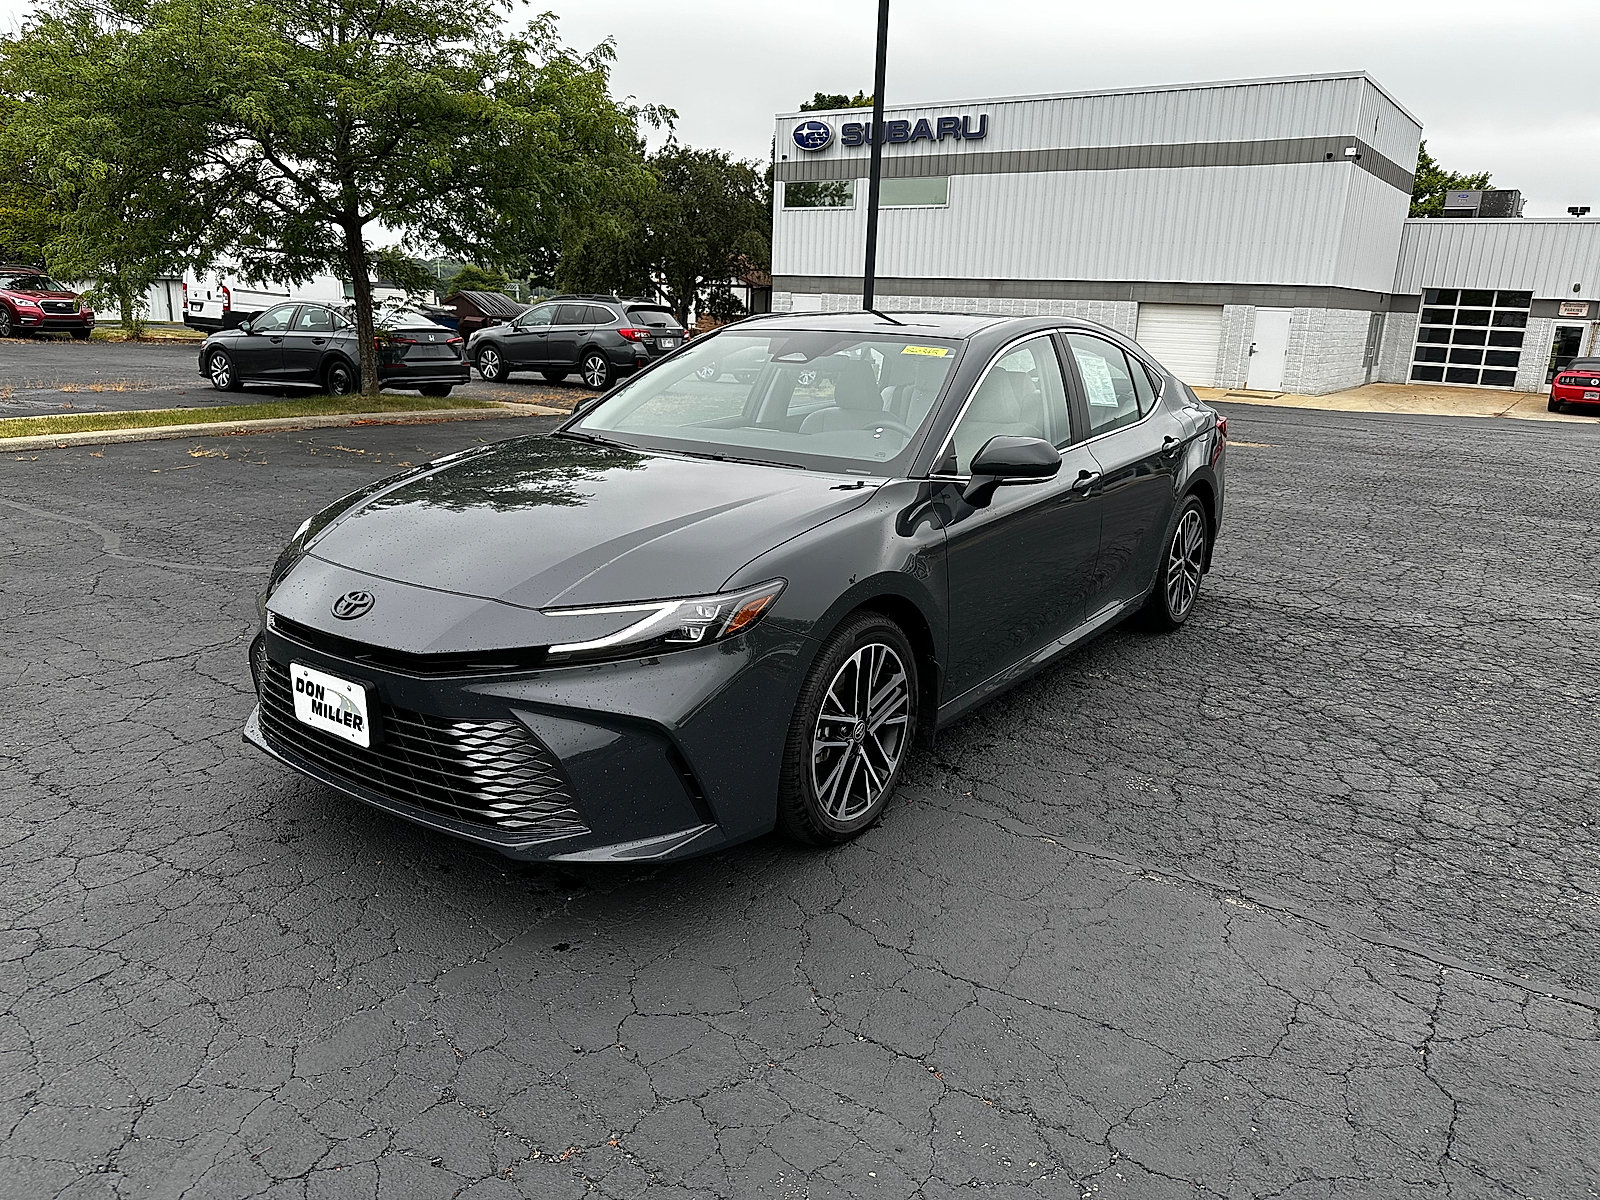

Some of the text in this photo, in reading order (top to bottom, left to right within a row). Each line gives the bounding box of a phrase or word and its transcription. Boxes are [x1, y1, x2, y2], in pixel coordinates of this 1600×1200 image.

[841, 114, 988, 146] SUBARU
[296, 677, 325, 701] DON
[312, 699, 364, 732] MILLER
